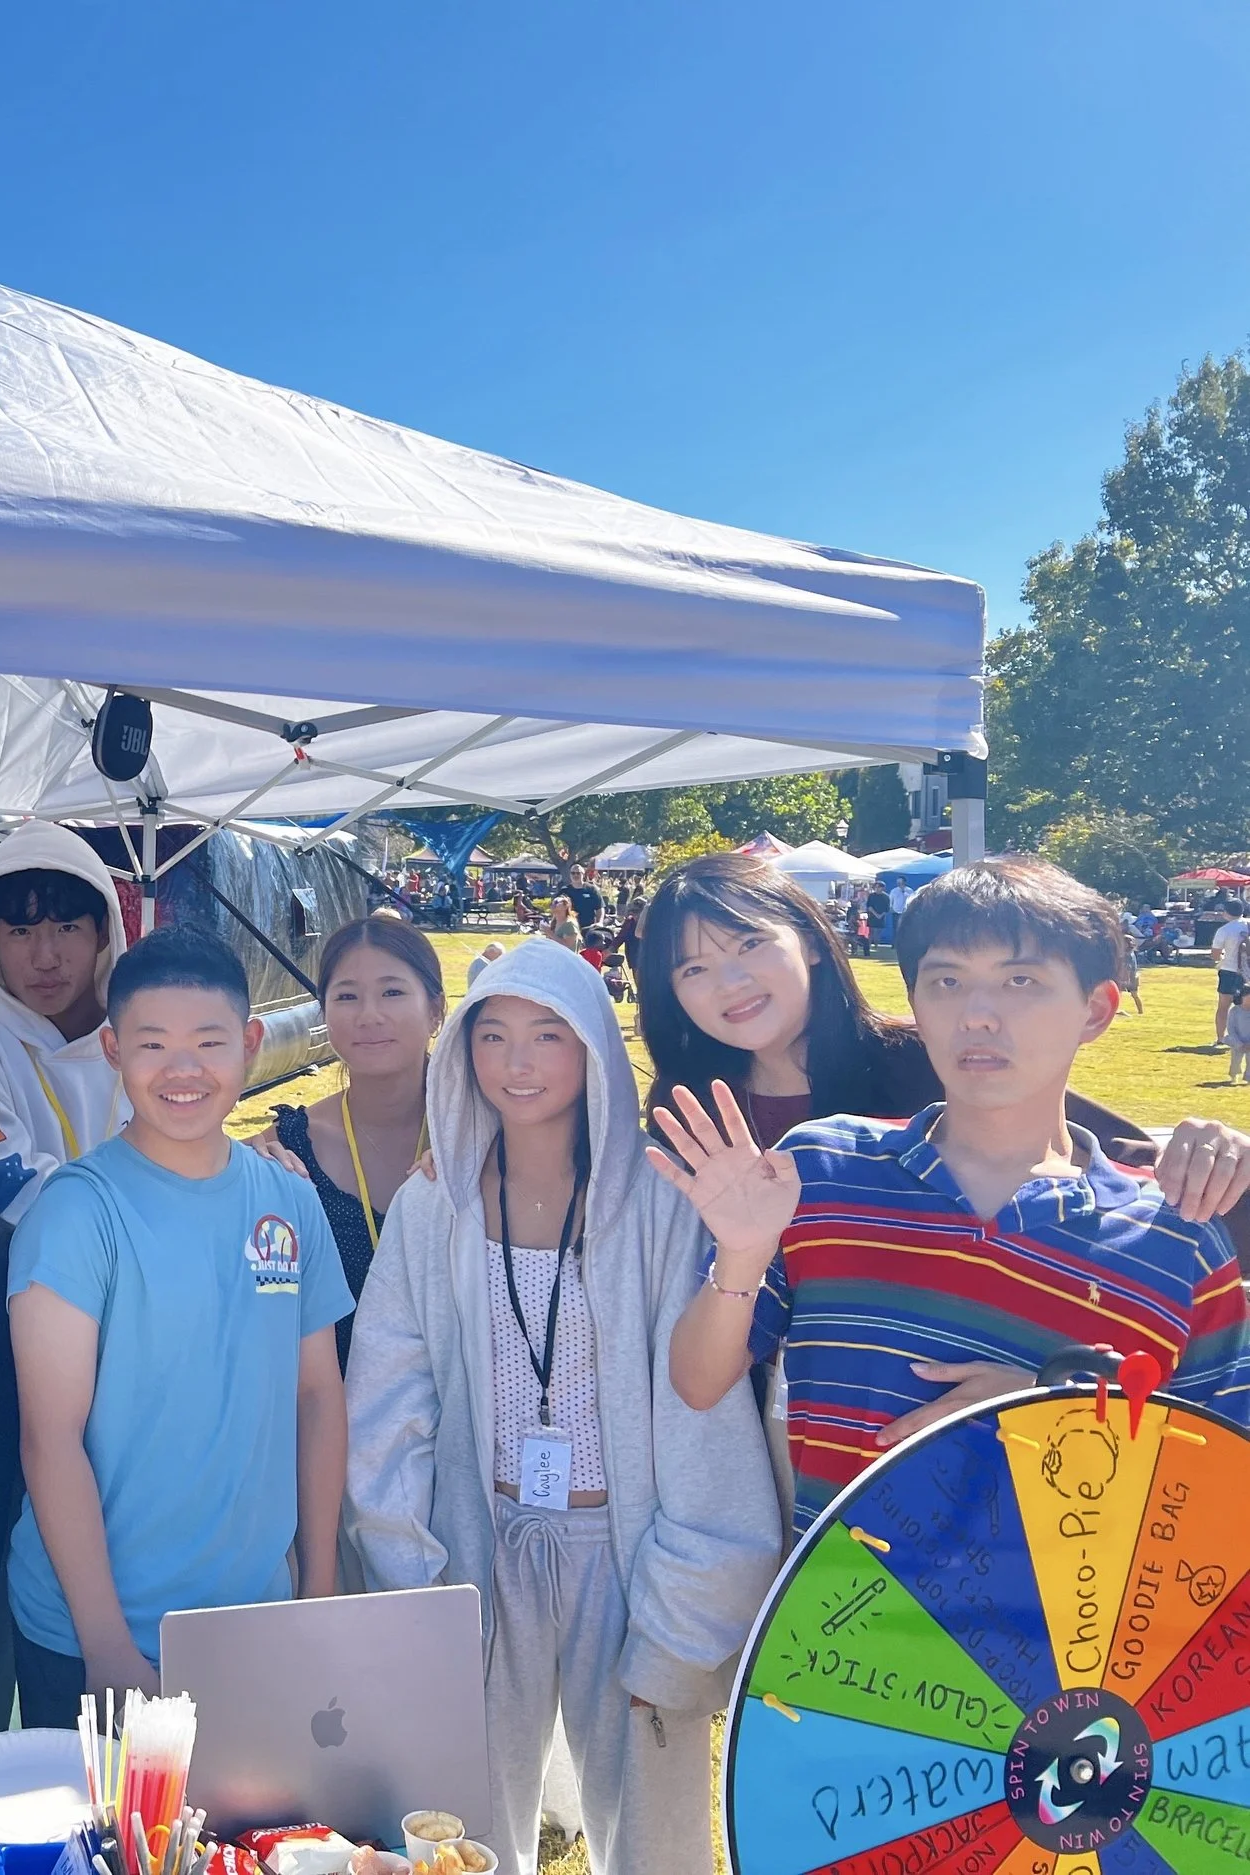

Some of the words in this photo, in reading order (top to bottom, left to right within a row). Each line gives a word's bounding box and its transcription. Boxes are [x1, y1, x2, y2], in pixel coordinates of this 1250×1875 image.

[121, 725, 149, 756] JBL
[257, 1260, 276, 1271] JUST
[1110, 1560, 1164, 1680] GOODIE
[1150, 1481, 1191, 1542] BAG
[1009, 1739, 1030, 1800] SPIN
[1023, 1709, 1049, 1734] TO
[1053, 1692, 1099, 1713] WIN
[1128, 1743, 1149, 1802] SPIN
[1059, 1829, 1106, 1850] WIN
[1109, 1807, 1135, 1832] TO
[1148, 1796, 1250, 1862] BRACEL
